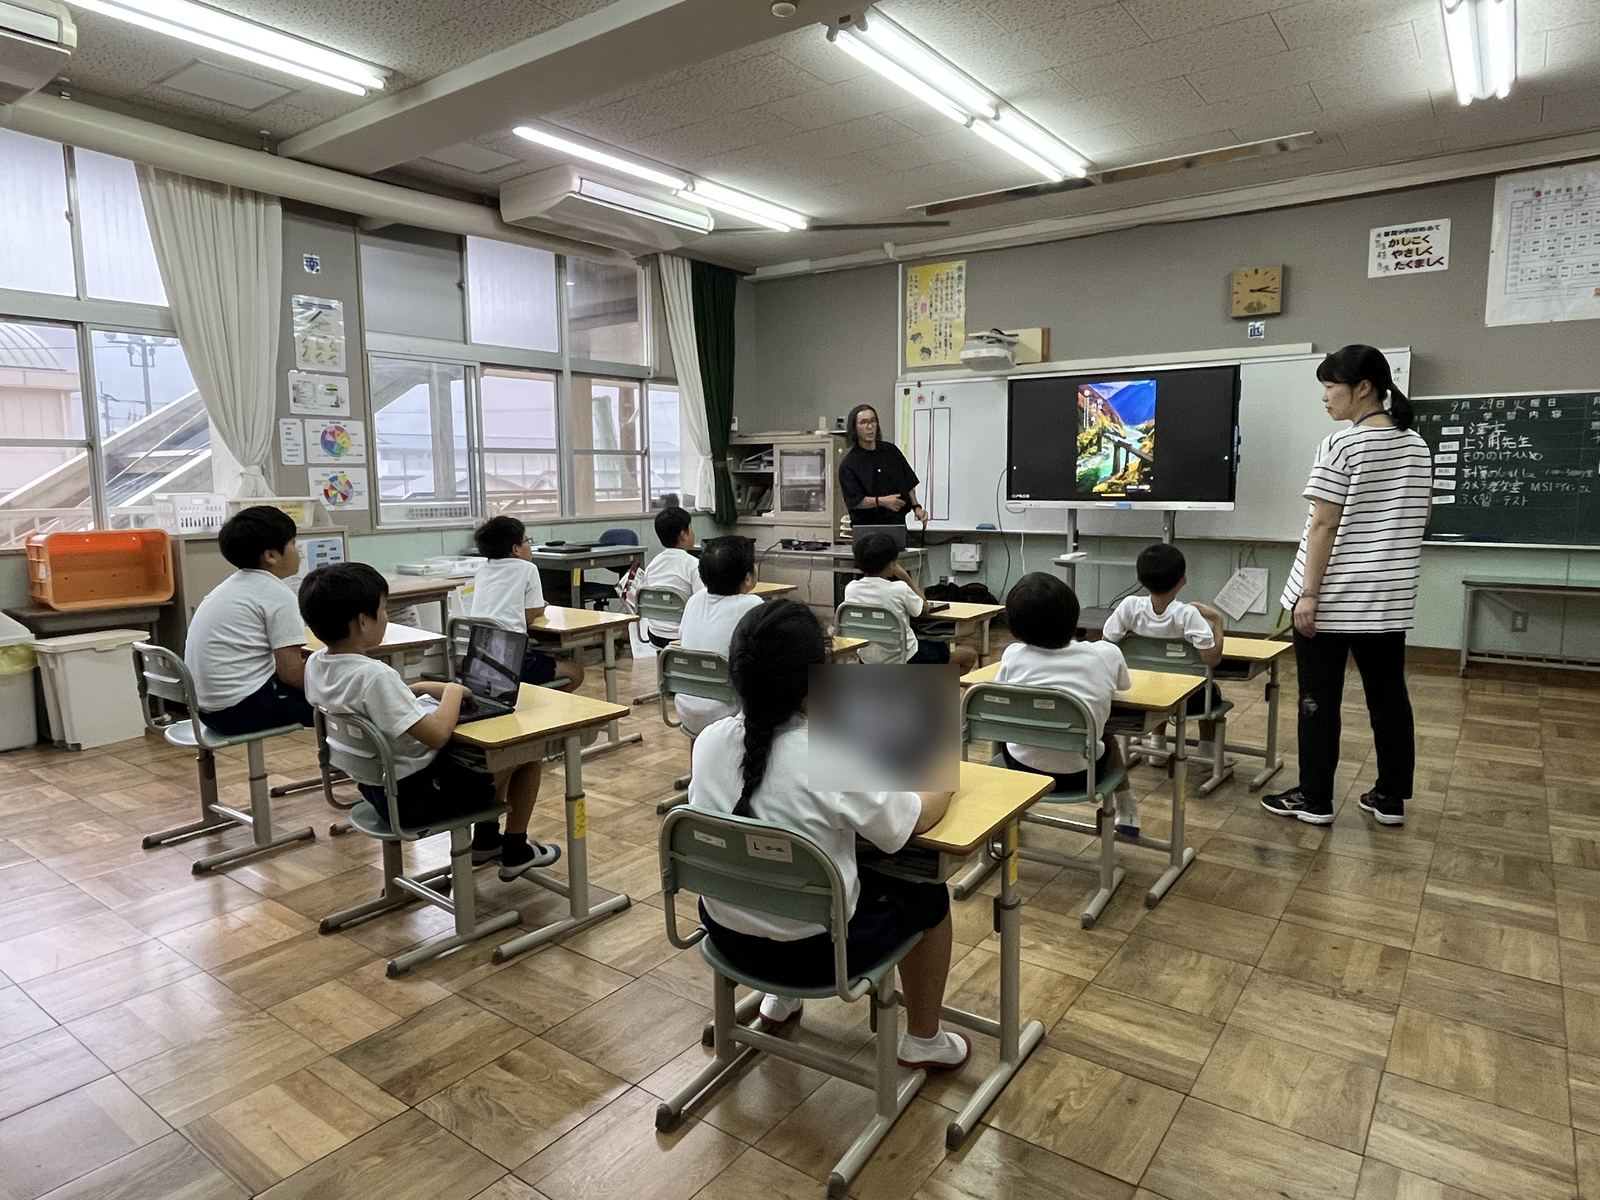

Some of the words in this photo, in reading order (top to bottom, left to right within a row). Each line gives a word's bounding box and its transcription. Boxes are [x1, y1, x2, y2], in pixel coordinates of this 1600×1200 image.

[1387, 234, 1431, 248] かしこく
[1391, 246, 1433, 259] やさしく
[1394, 256, 1445, 271] たくましく
[1503, 495, 1529, 507] テスト
